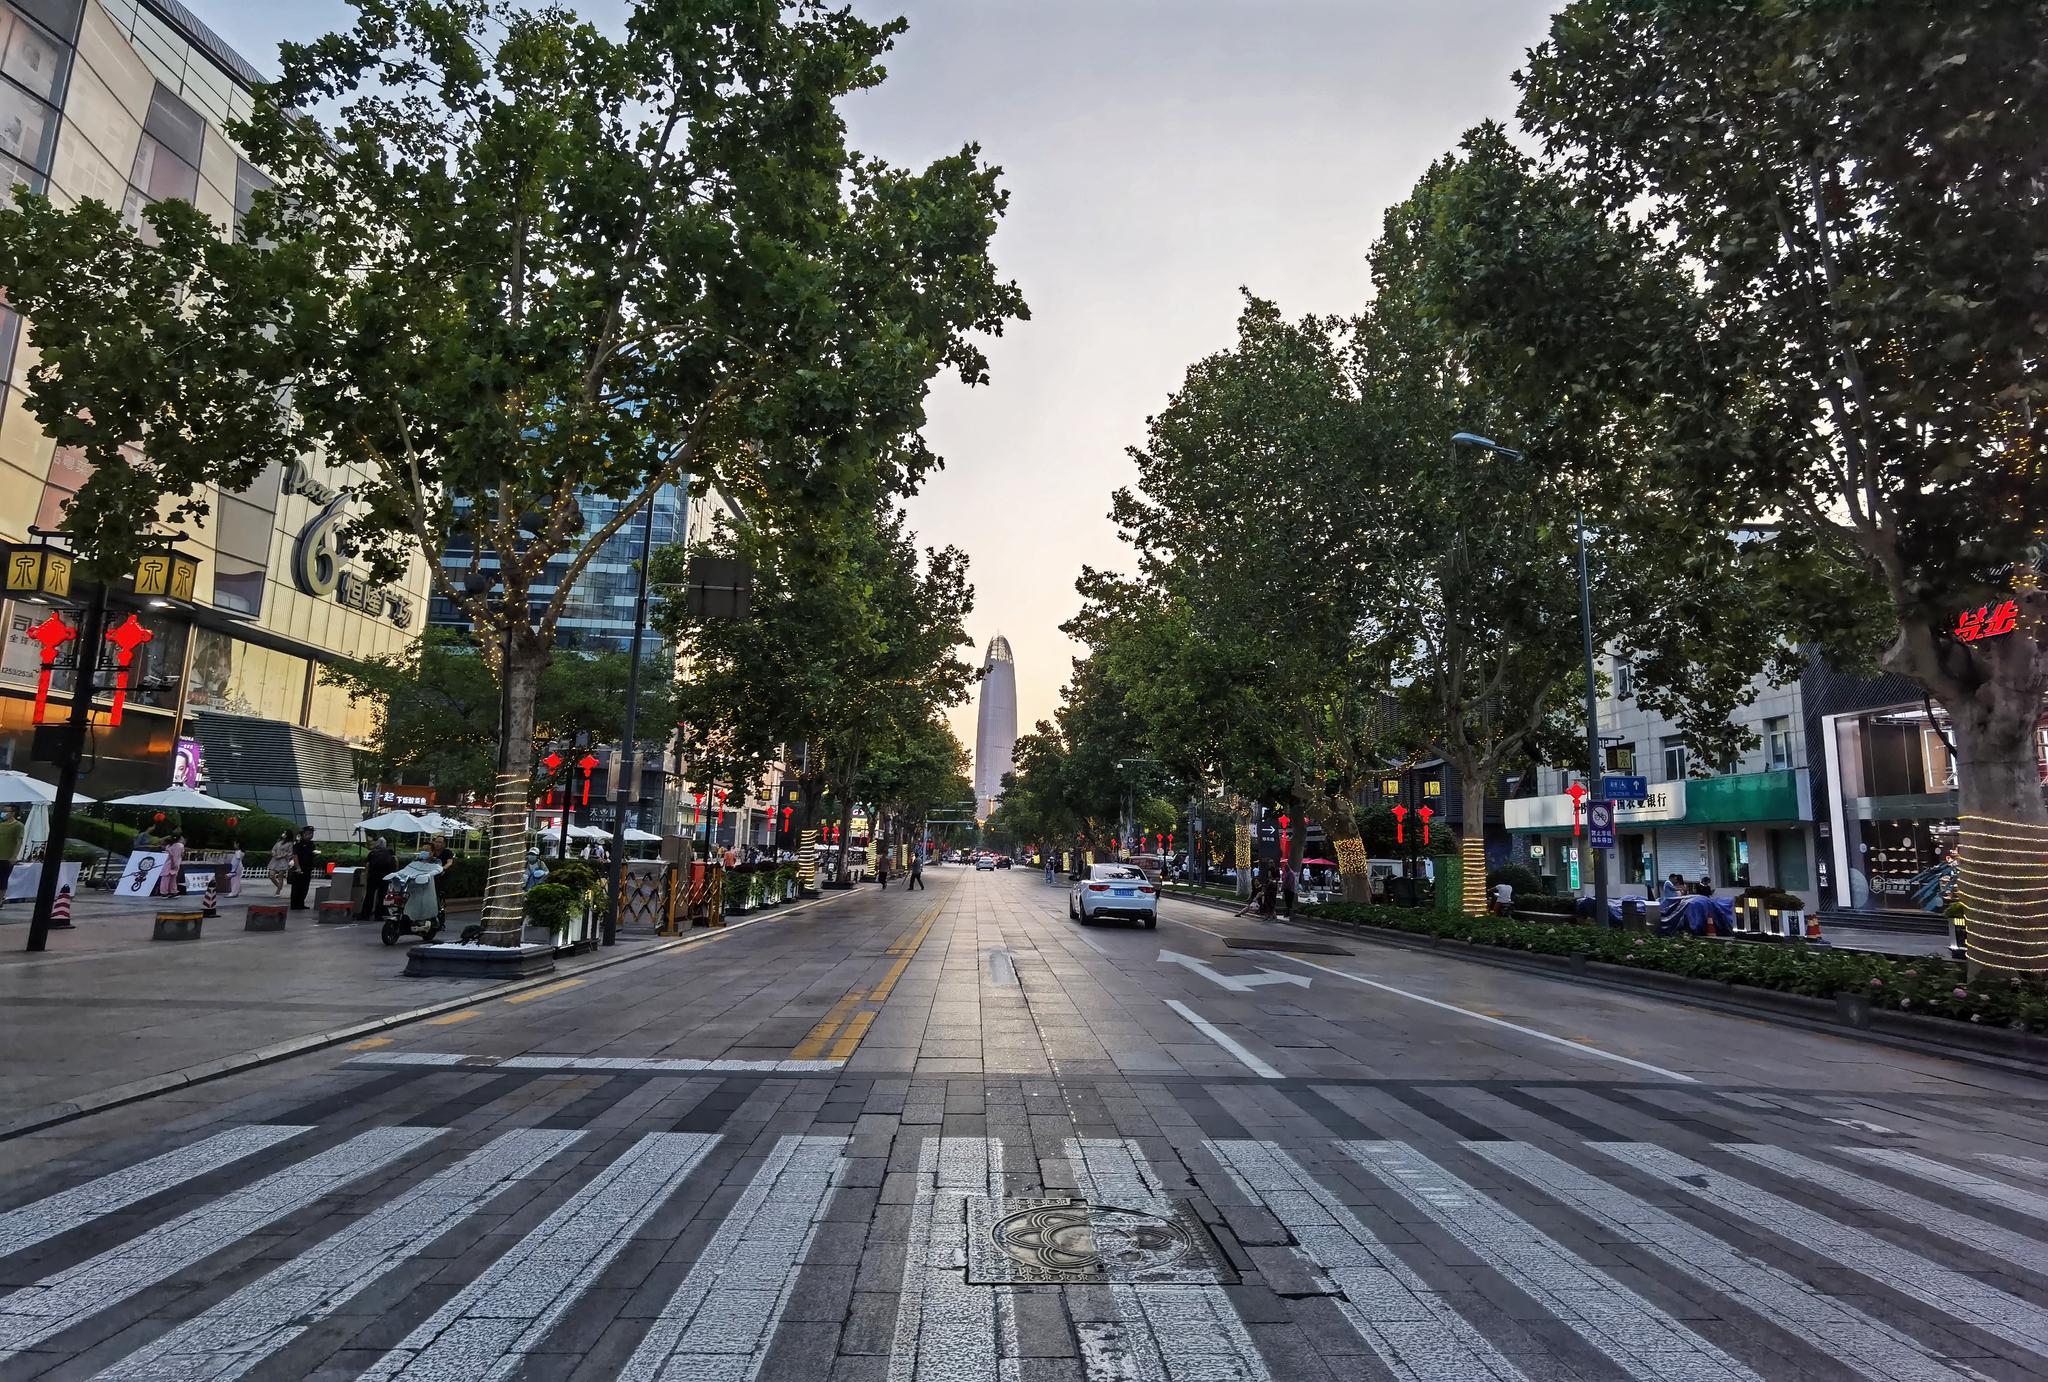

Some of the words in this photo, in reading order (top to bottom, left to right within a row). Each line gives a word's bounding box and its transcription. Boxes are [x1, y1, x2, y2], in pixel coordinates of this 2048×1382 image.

[338, 571, 414, 629] 恒隆广场
[1613, 793, 1667, 810] 国农业银行
